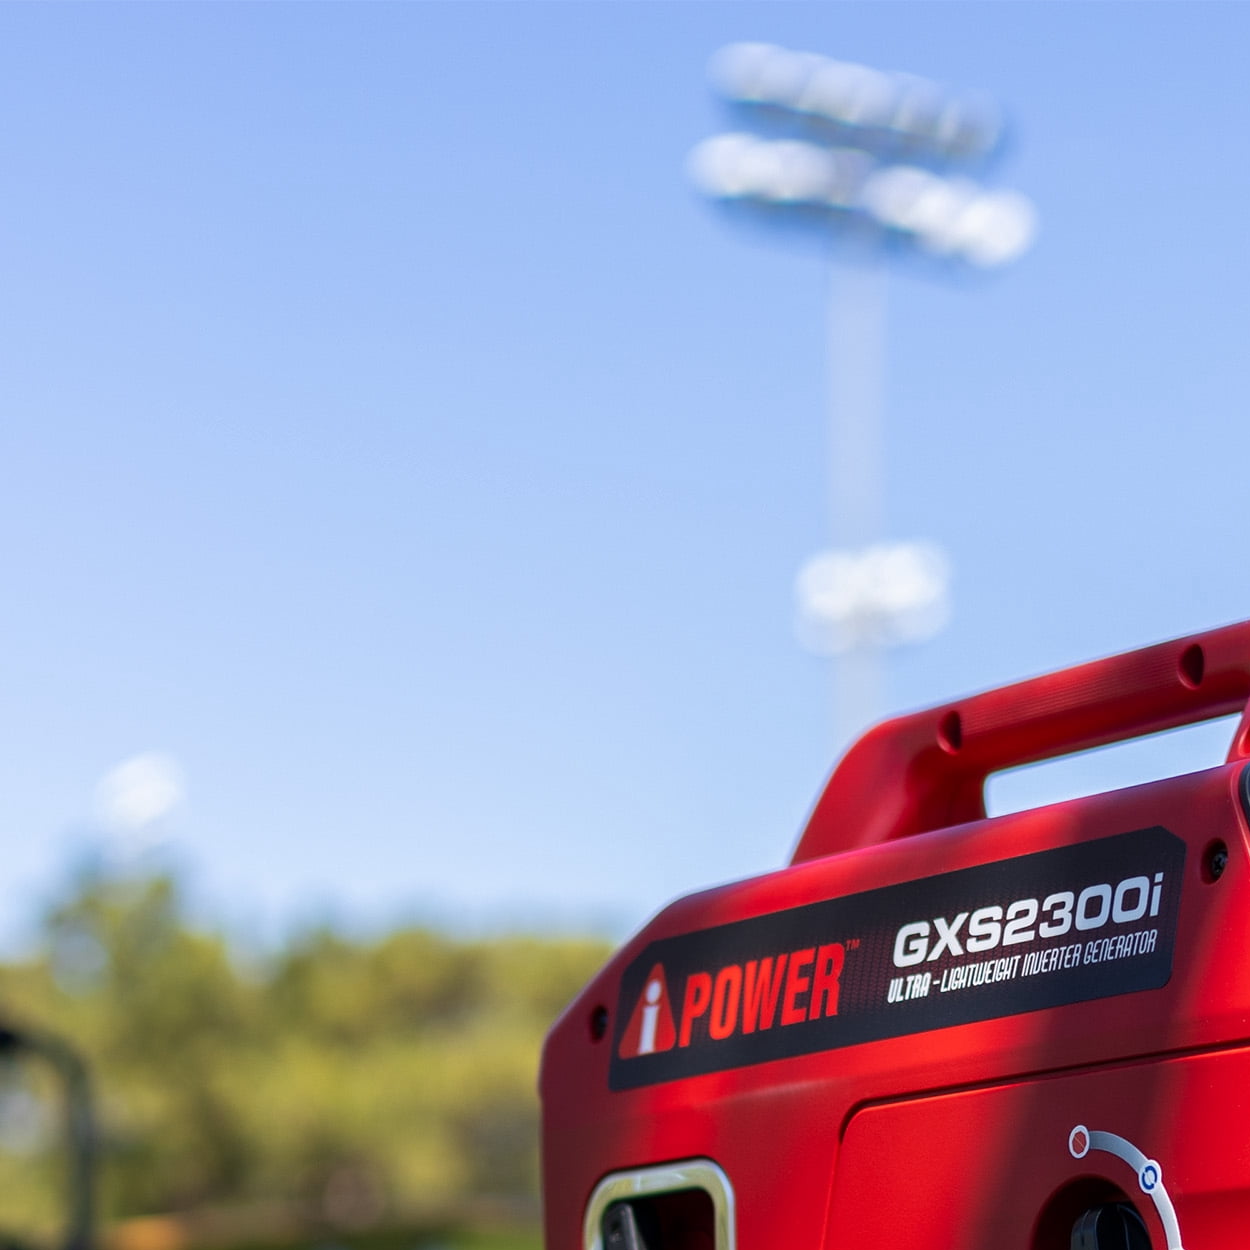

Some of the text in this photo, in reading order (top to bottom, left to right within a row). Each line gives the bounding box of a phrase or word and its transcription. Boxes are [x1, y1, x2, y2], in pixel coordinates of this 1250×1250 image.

[893, 872, 1164, 968] GXS2300i
[1022, 944, 1081, 977] INVERTER
[1083, 929, 1158, 964] GENERATOR
[678, 942, 846, 1048] POWER
